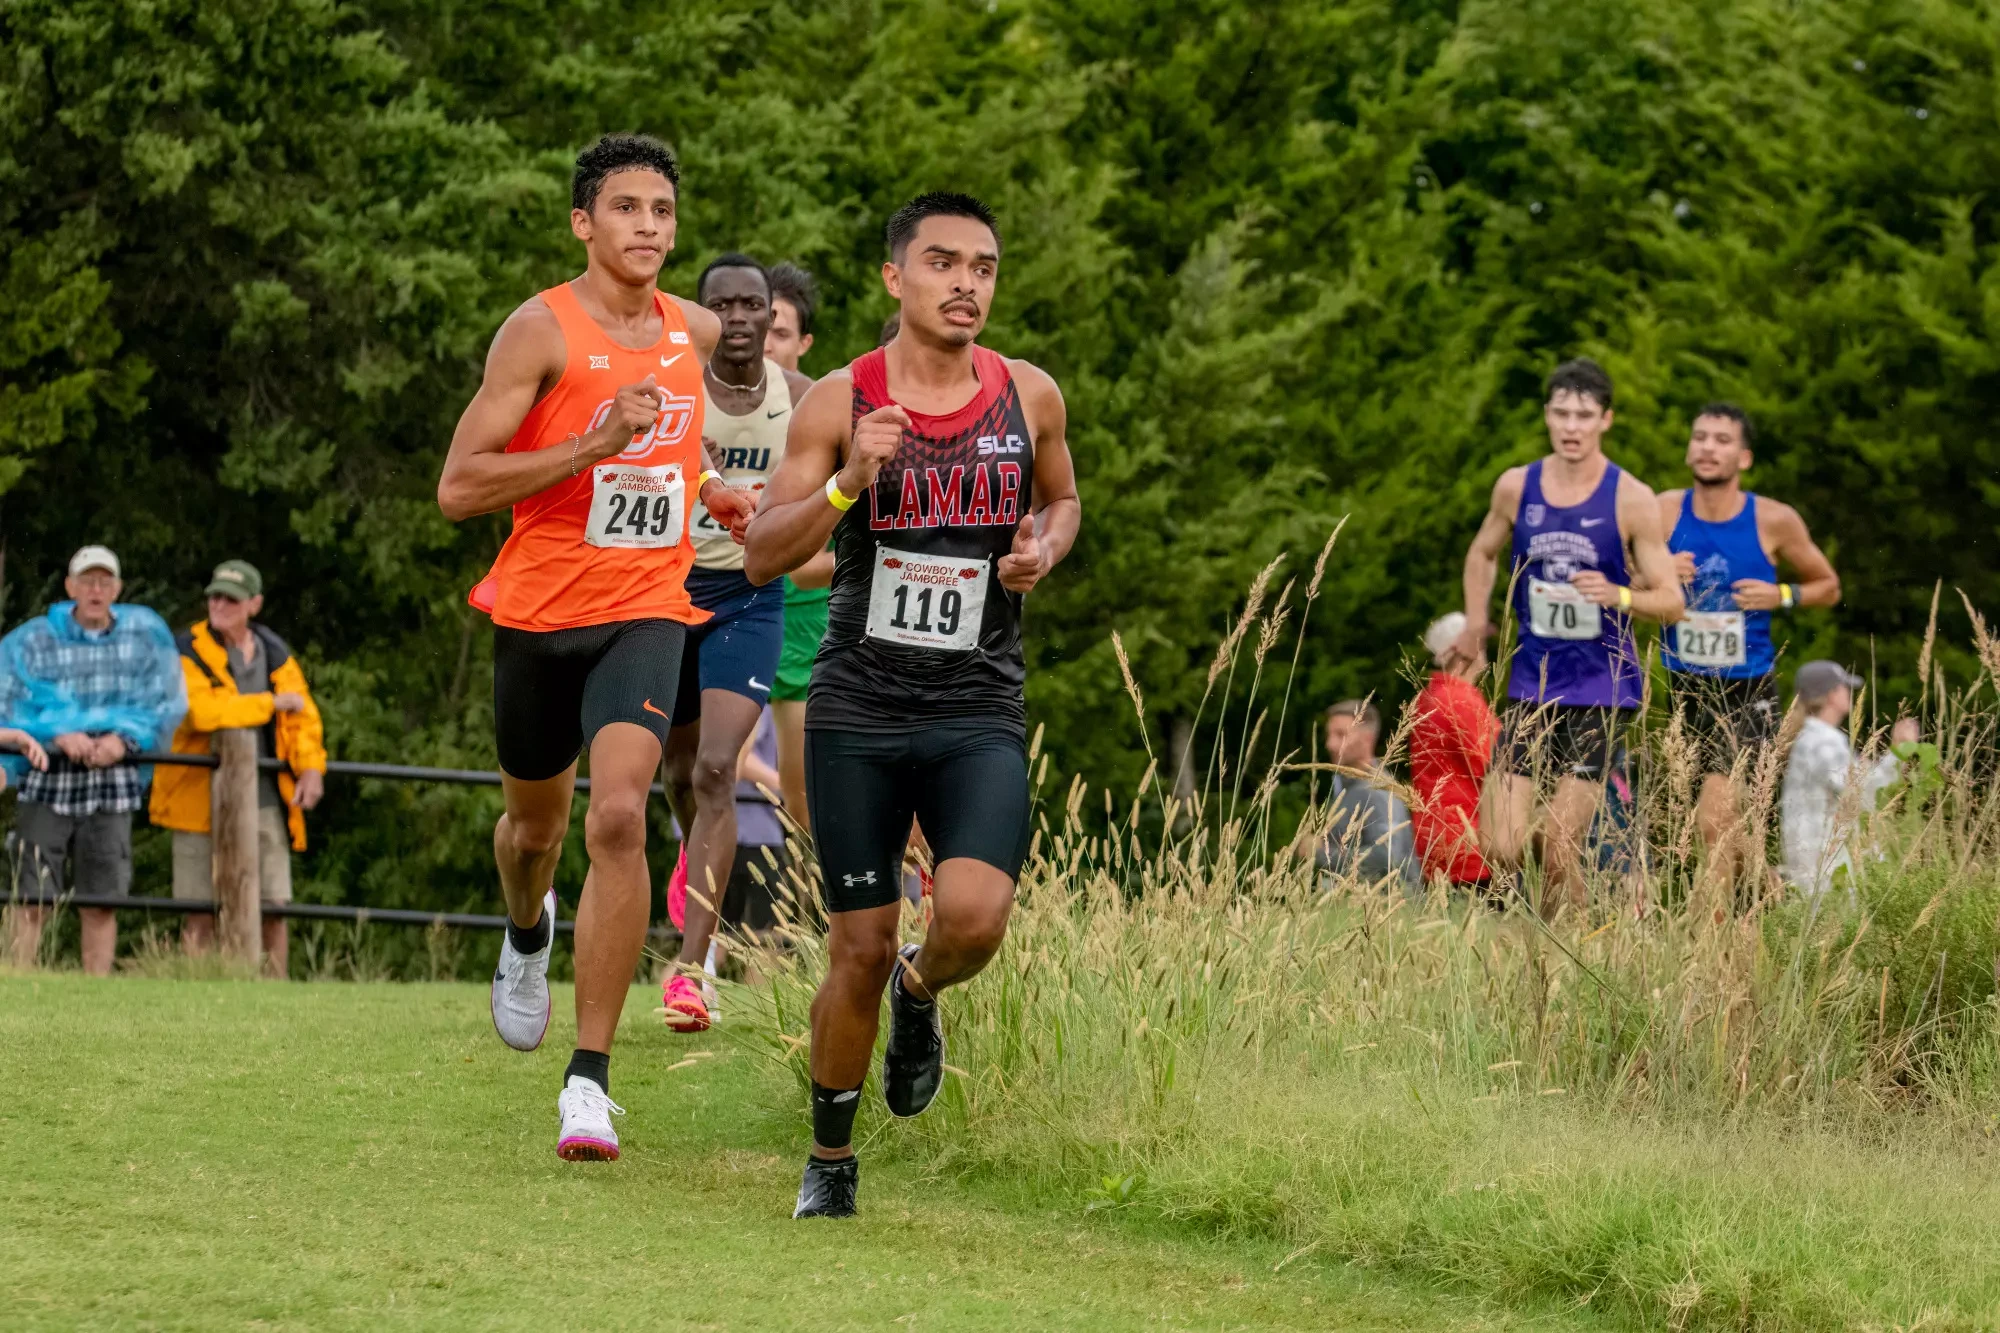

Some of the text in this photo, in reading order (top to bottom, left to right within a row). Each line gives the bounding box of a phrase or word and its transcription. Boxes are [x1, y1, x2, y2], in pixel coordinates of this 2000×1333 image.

[977, 434, 1022, 455] SLC
[721, 447, 771, 471] RU
[615, 482, 667, 493] JAMBOREE
[620, 473, 663, 484] COWBOY
[869, 461, 1021, 531] LAMAR
[604, 493, 670, 536] 249
[899, 571, 958, 587] JAMBOREE
[905, 562, 955, 576] COWBOY
[889, 584, 962, 636] 119
[1547, 602, 1576, 629] 70
